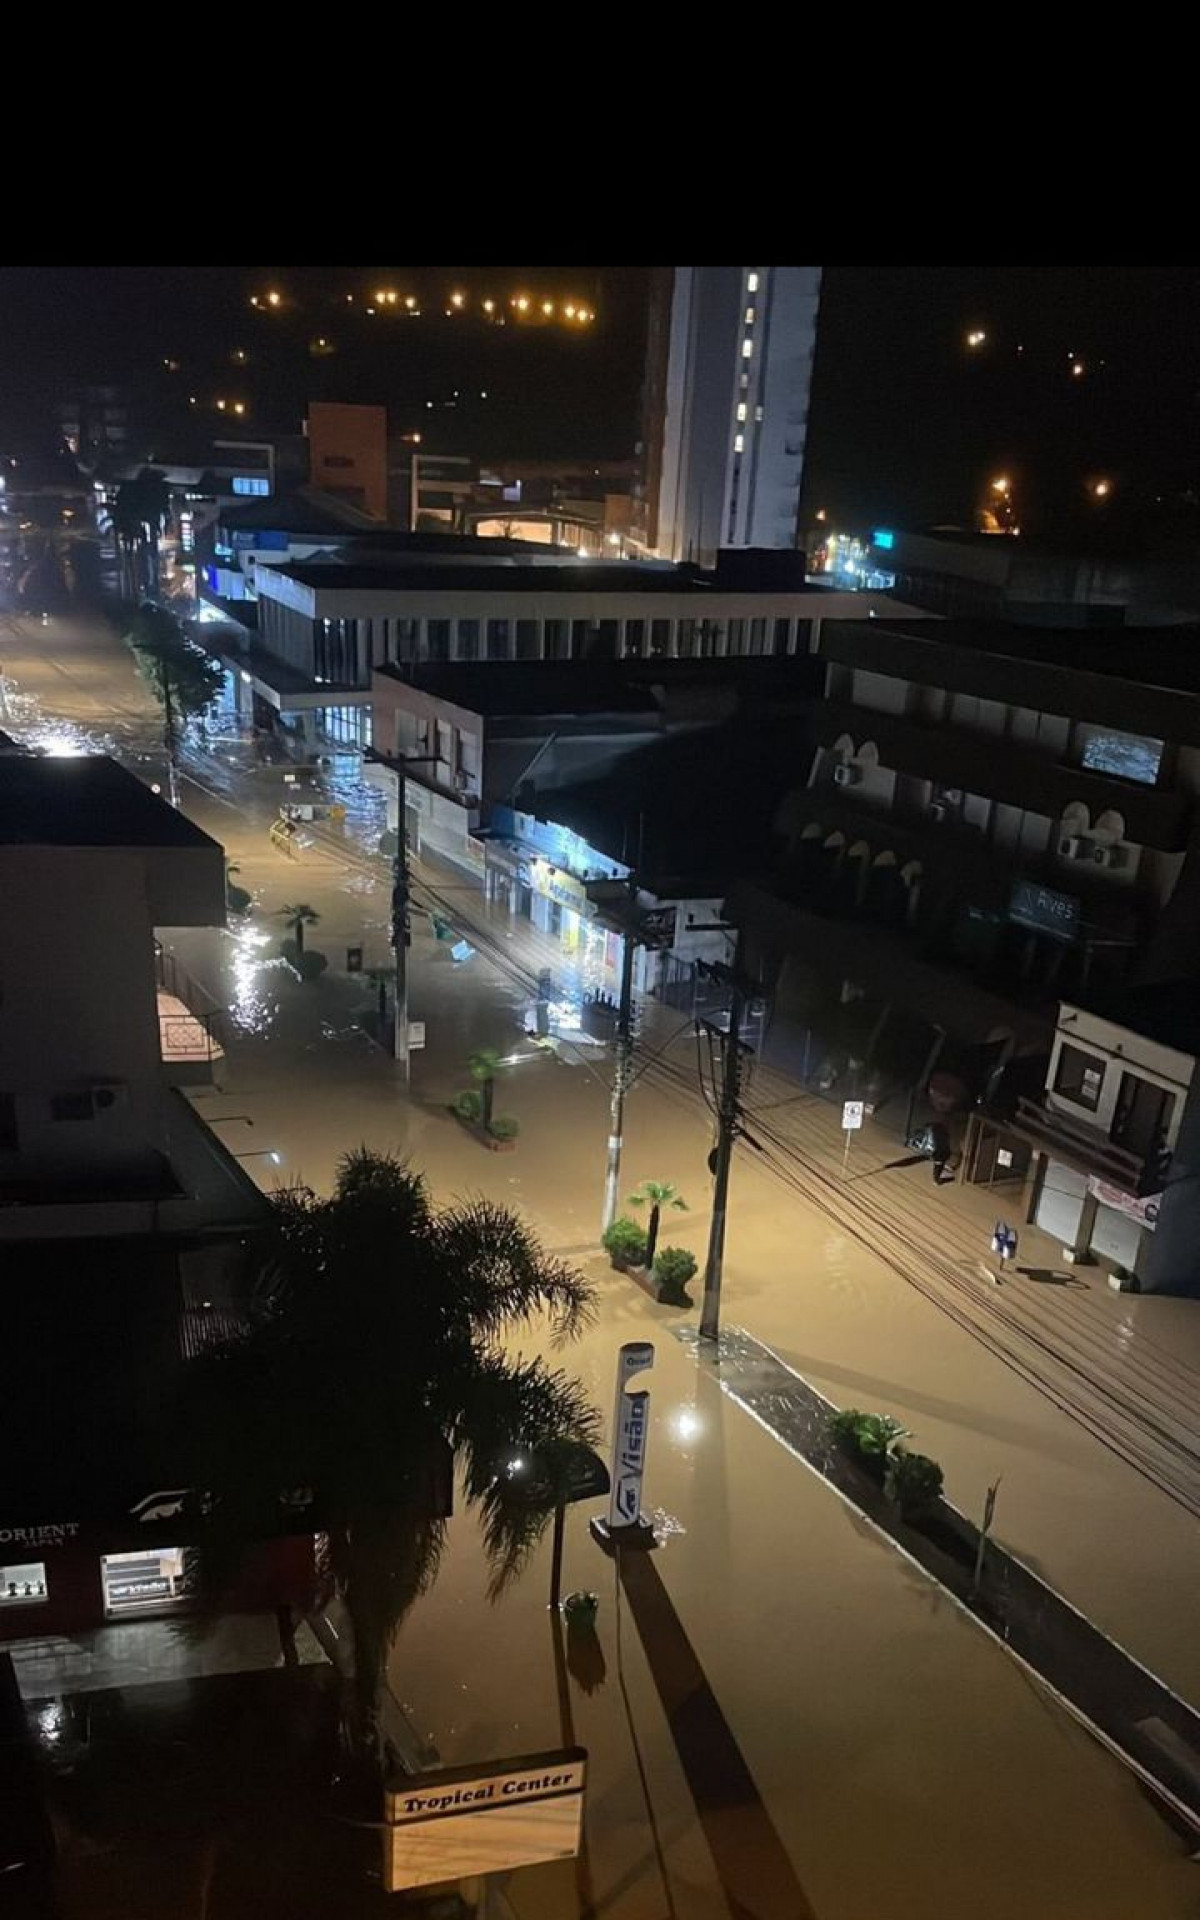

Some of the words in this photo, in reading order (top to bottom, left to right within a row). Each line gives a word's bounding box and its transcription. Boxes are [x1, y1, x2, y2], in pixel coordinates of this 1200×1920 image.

[621, 1398, 644, 1479] Visão
[0, 1522, 80, 1543] ORIENT
[404, 1784, 495, 1812] Tropical
[501, 1773, 573, 1795] Center
